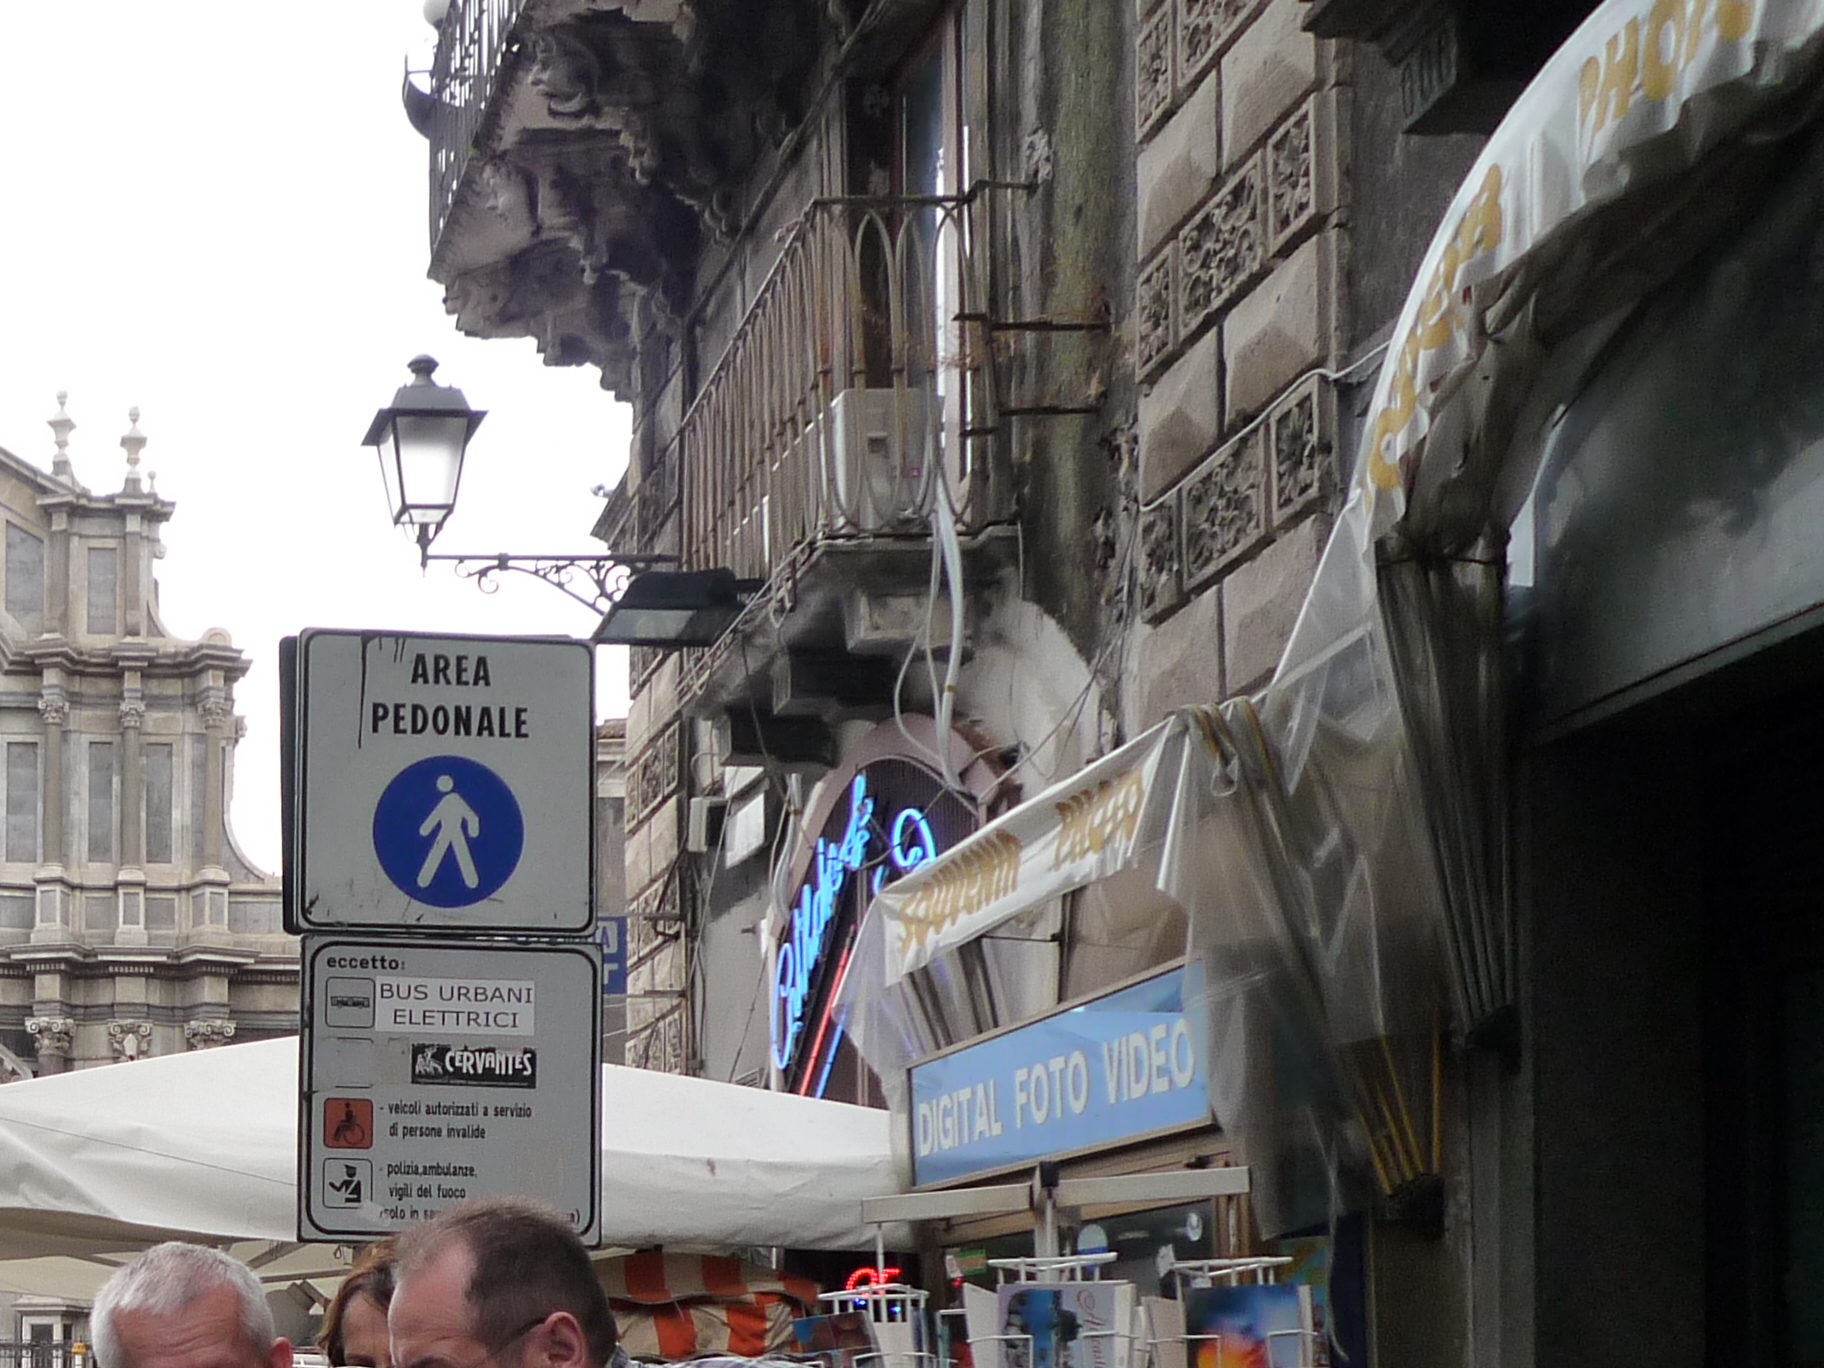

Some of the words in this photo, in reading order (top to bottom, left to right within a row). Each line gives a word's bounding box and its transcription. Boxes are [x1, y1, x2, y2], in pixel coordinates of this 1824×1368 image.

[411, 653, 491, 687] AREA
[372, 702, 530, 738] PEDONALE
[380, 983, 429, 1001] BUS
[439, 985, 533, 1004] URBANI
[393, 1008, 519, 1028] ELETTRICI
[444, 1049, 533, 1076] CERVANTES
[918, 1079, 1003, 1158] DIGITAL
[1014, 1050, 1089, 1130] FOTO
[1103, 1018, 1196, 1104] VIDEO
[388, 1099, 421, 1115] veicoli
[426, 1100, 479, 1117] autorizzati
[482, 1105, 489, 1117] a
[493, 1103, 533, 1118] servizio
[389, 1121, 399, 1137] di
[402, 1125, 443, 1140] persone
[447, 1123, 486, 1139] invalide
[389, 1183, 413, 1201] vigili
[416, 1184, 433, 1199] del
[437, 1184, 466, 1199] fuoco
[409, 1206, 420, 1220] in
